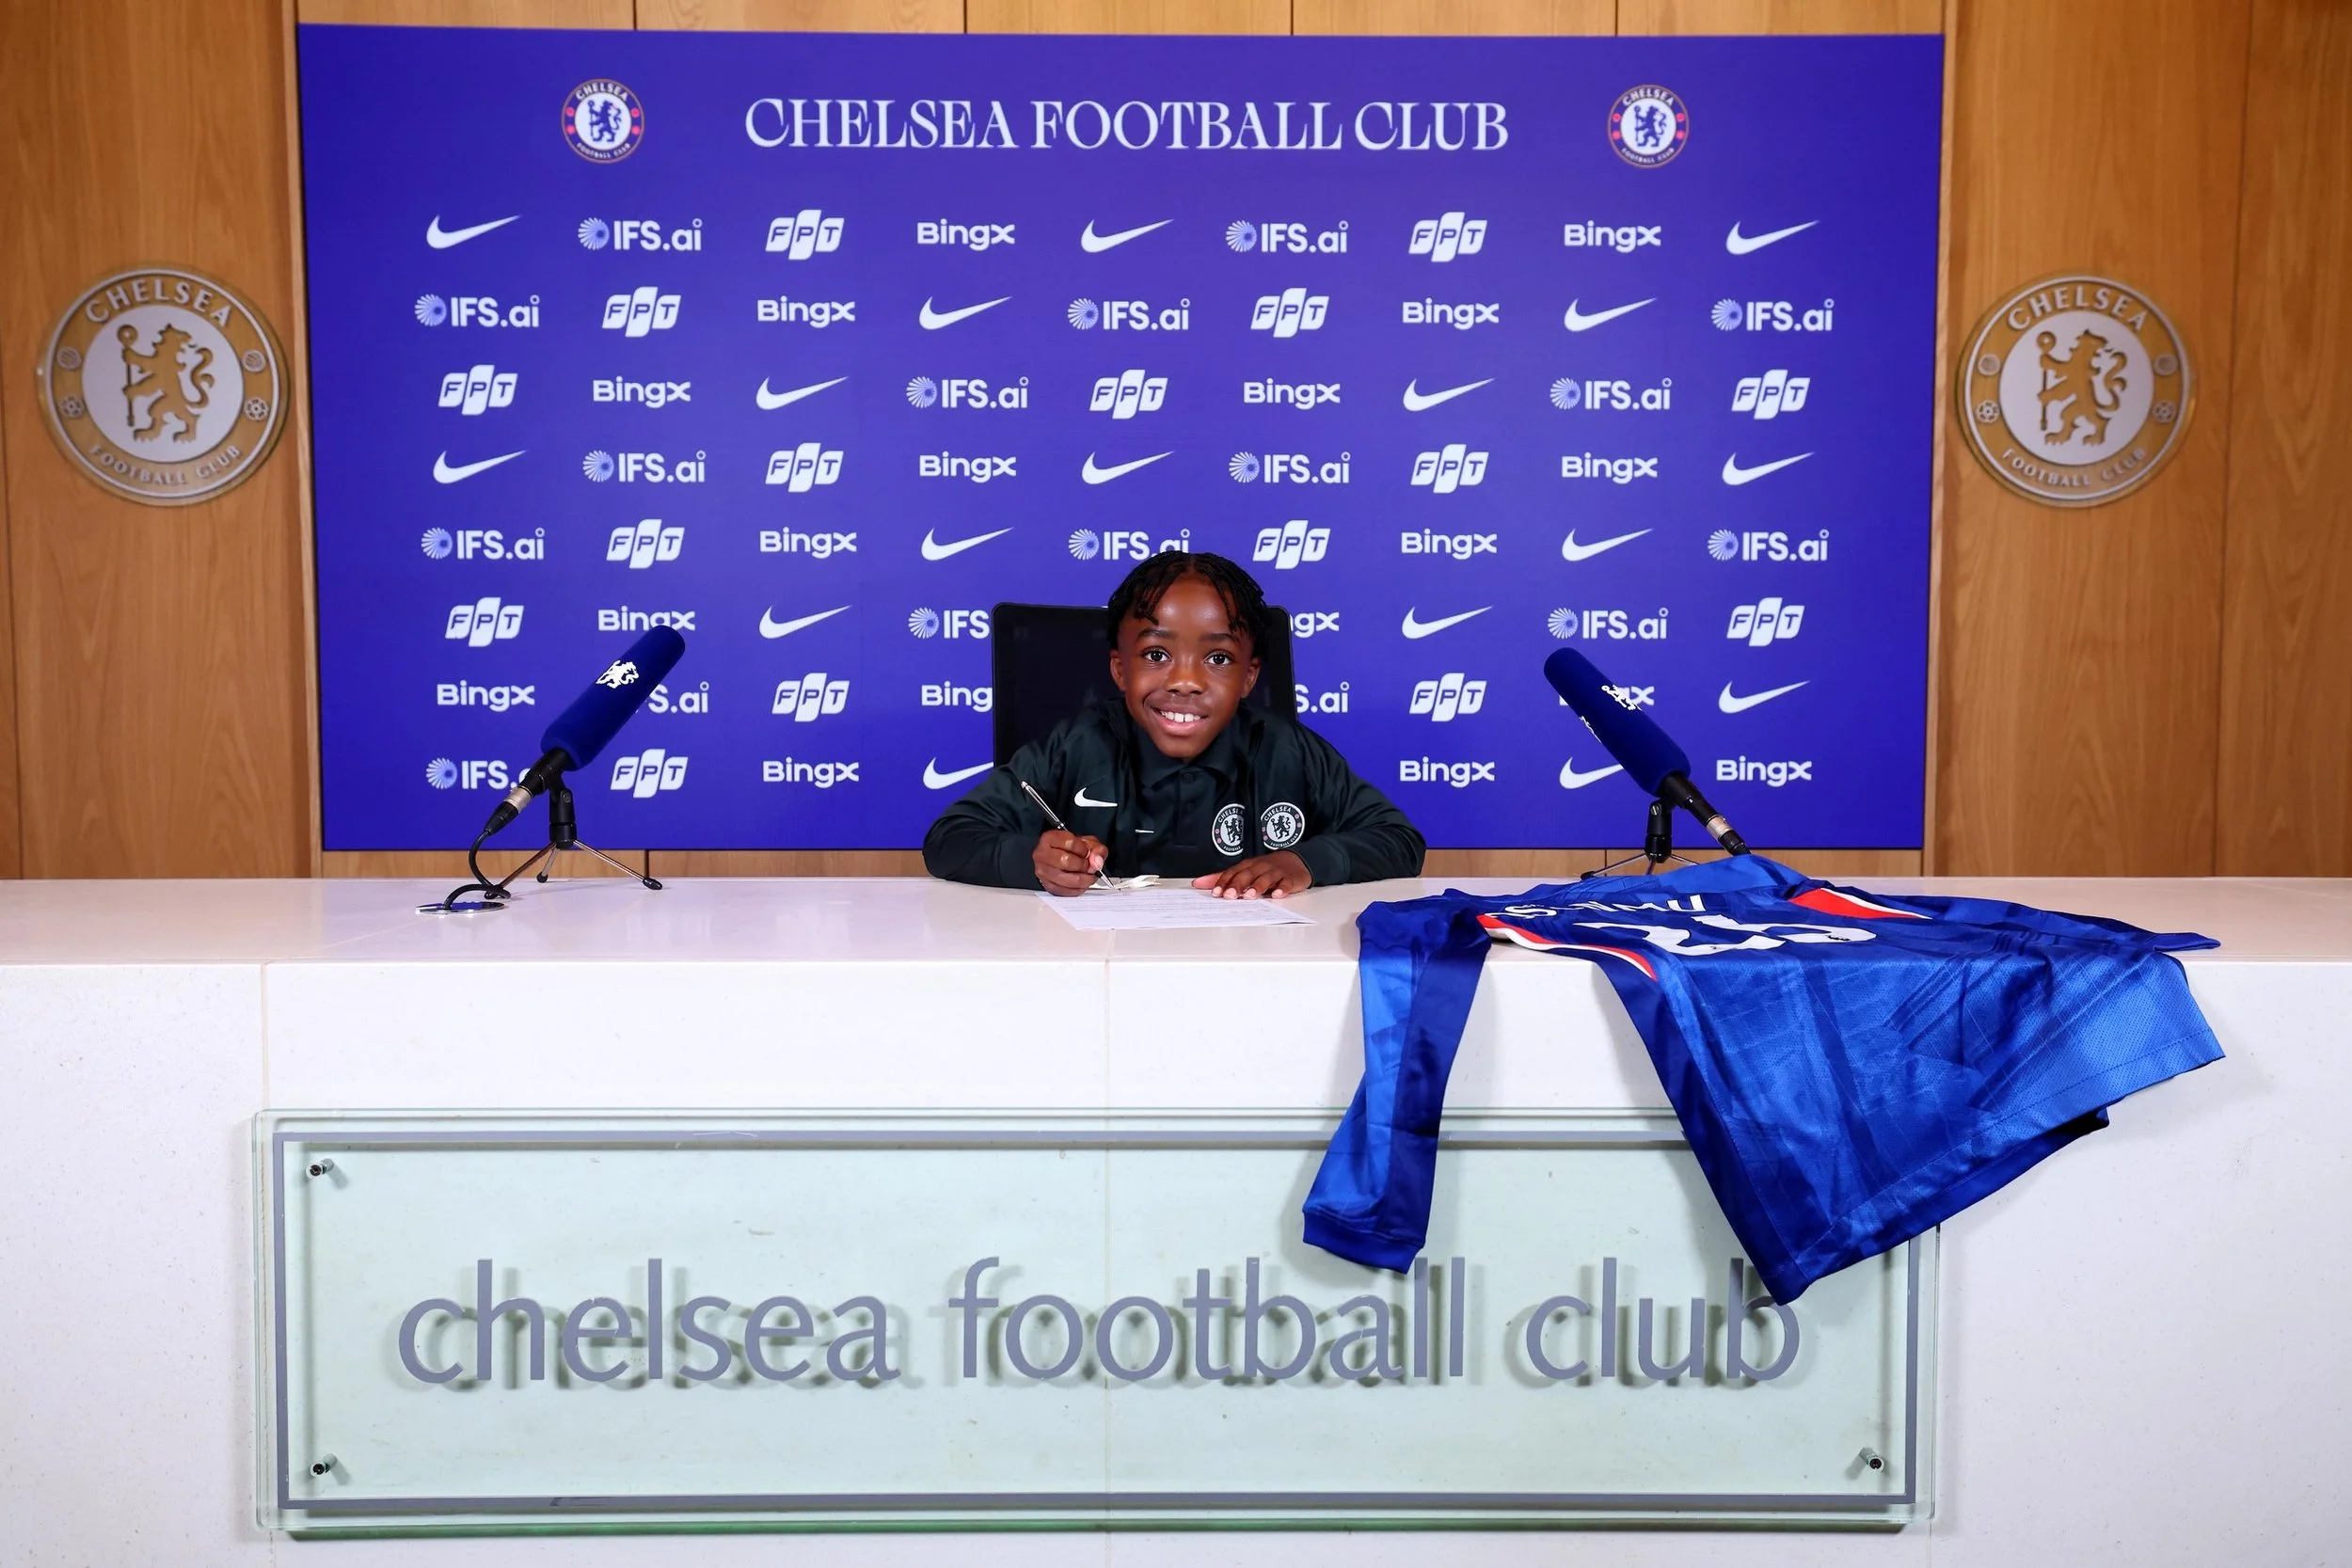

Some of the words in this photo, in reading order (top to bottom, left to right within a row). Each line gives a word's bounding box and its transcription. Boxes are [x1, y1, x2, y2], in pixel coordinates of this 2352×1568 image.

[745, 99, 1020, 149] CHELSEA
[1030, 100, 1343, 150] FOOTBALL
[1354, 102, 1509, 151] CLUB
[613, 218, 702, 251] IFS.ai
[1261, 220, 1348, 253] IFS.ai
[86, 278, 231, 328] CHELSEA
[450, 294, 539, 327] IFS.ai
[1103, 298, 1190, 330] IFS.ai
[1746, 299, 1834, 331] IFS.ai
[2007, 285, 2148, 332] CHELSEA
[941, 376, 1028, 408] IFS.ai
[1585, 378, 1672, 410] IFS.ai
[618, 451, 706, 483] IFS.ai
[1263, 451, 1350, 483] IFS.ai
[2002, 448, 2090, 486] FOOTBALL
[456, 528, 545, 560] IFS.ai
[1742, 530, 1829, 561] IFS.ai
[1582, 608, 1668, 639] IFS.ai
[1263, 806, 1292, 821] CHELSEA
[398, 1258, 902, 1384] chelsea
[948, 1257, 1465, 1381] football
[1526, 1257, 1801, 1381] club
